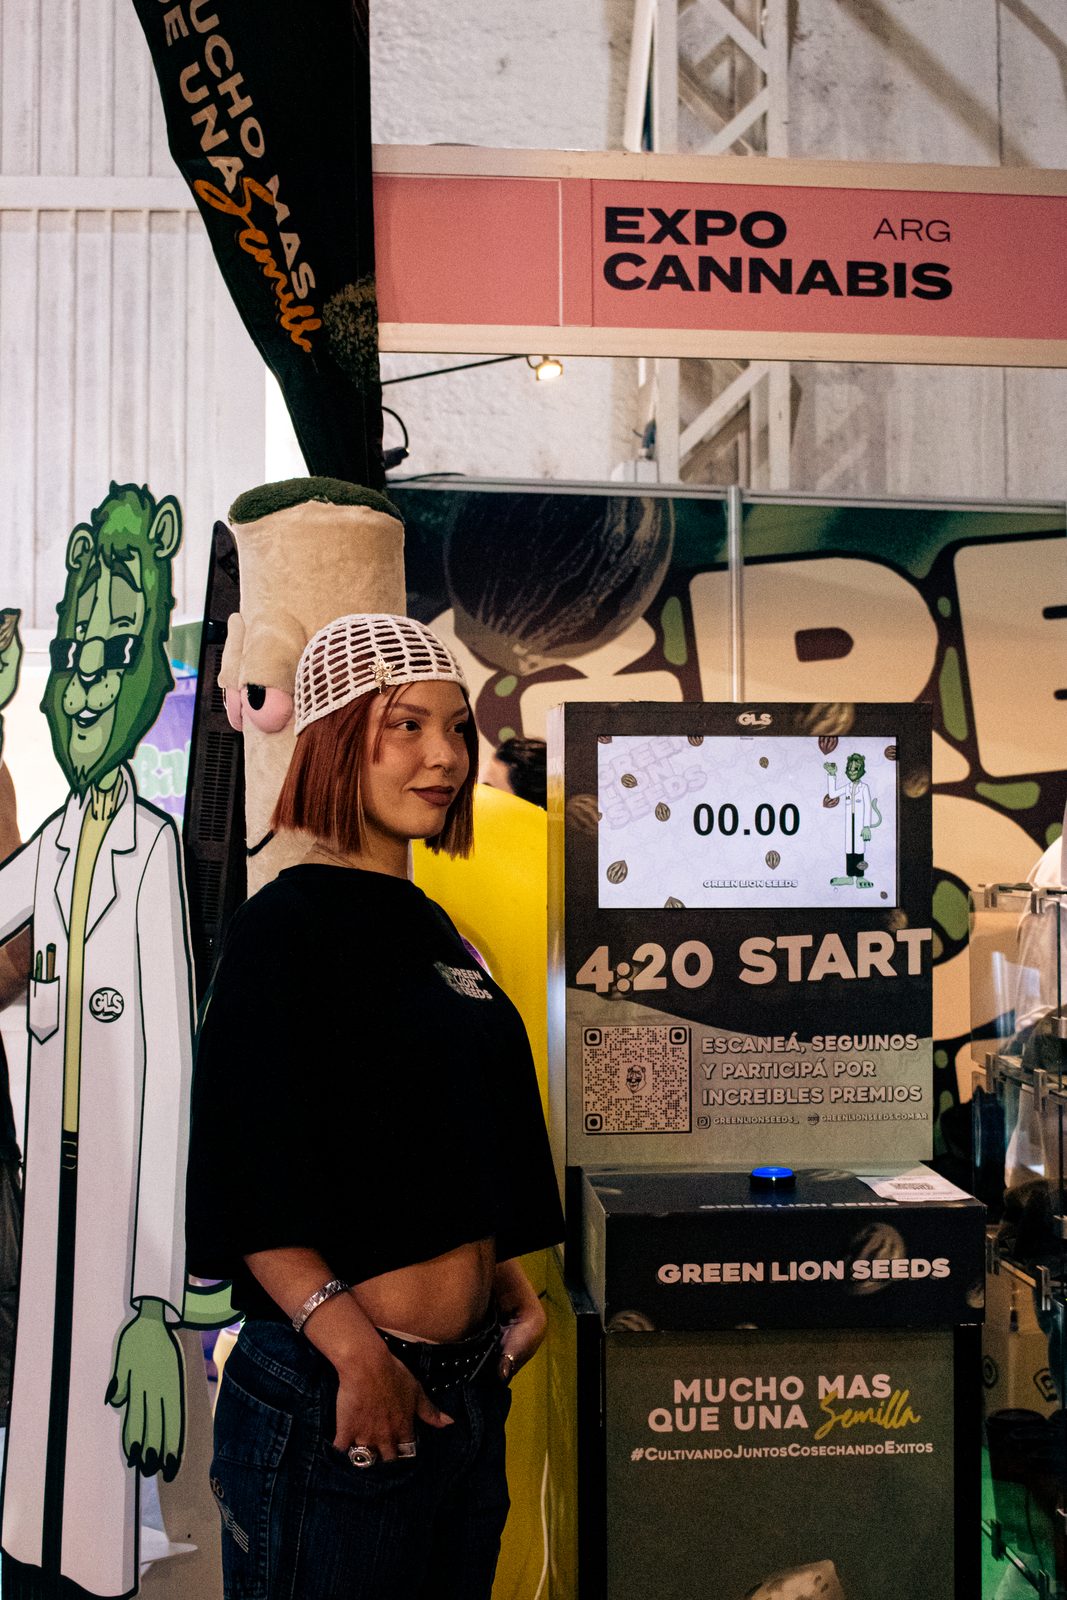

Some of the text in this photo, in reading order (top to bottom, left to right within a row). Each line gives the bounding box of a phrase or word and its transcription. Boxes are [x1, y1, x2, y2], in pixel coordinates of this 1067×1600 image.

[189, 0, 265, 158] UCHO
[179, 62, 244, 193] UNA
[604, 206, 952, 249] EXPO ARG
[603, 251, 954, 301] CANNABIS
[738, 712, 772, 726] GLS
[693, 803, 801, 836] 00.00
[703, 880, 798, 888] GREEN LION SEEDS
[576, 927, 932, 993] 4:20 START
[91, 990, 124, 1015] GLS
[701, 1032, 918, 1054] ESCANEÁ, SEGUINOS
[701, 1058, 876, 1080] Y PARTICIPÁ POR
[702, 1085, 923, 1105] INCREIBLES PREMIOS
[657, 1258, 951, 1285] GREEN LION SEEDS
[673, 1374, 892, 1404] MUCHO MAS
[647, 1390, 922, 1441] QUE UNA Semilla
